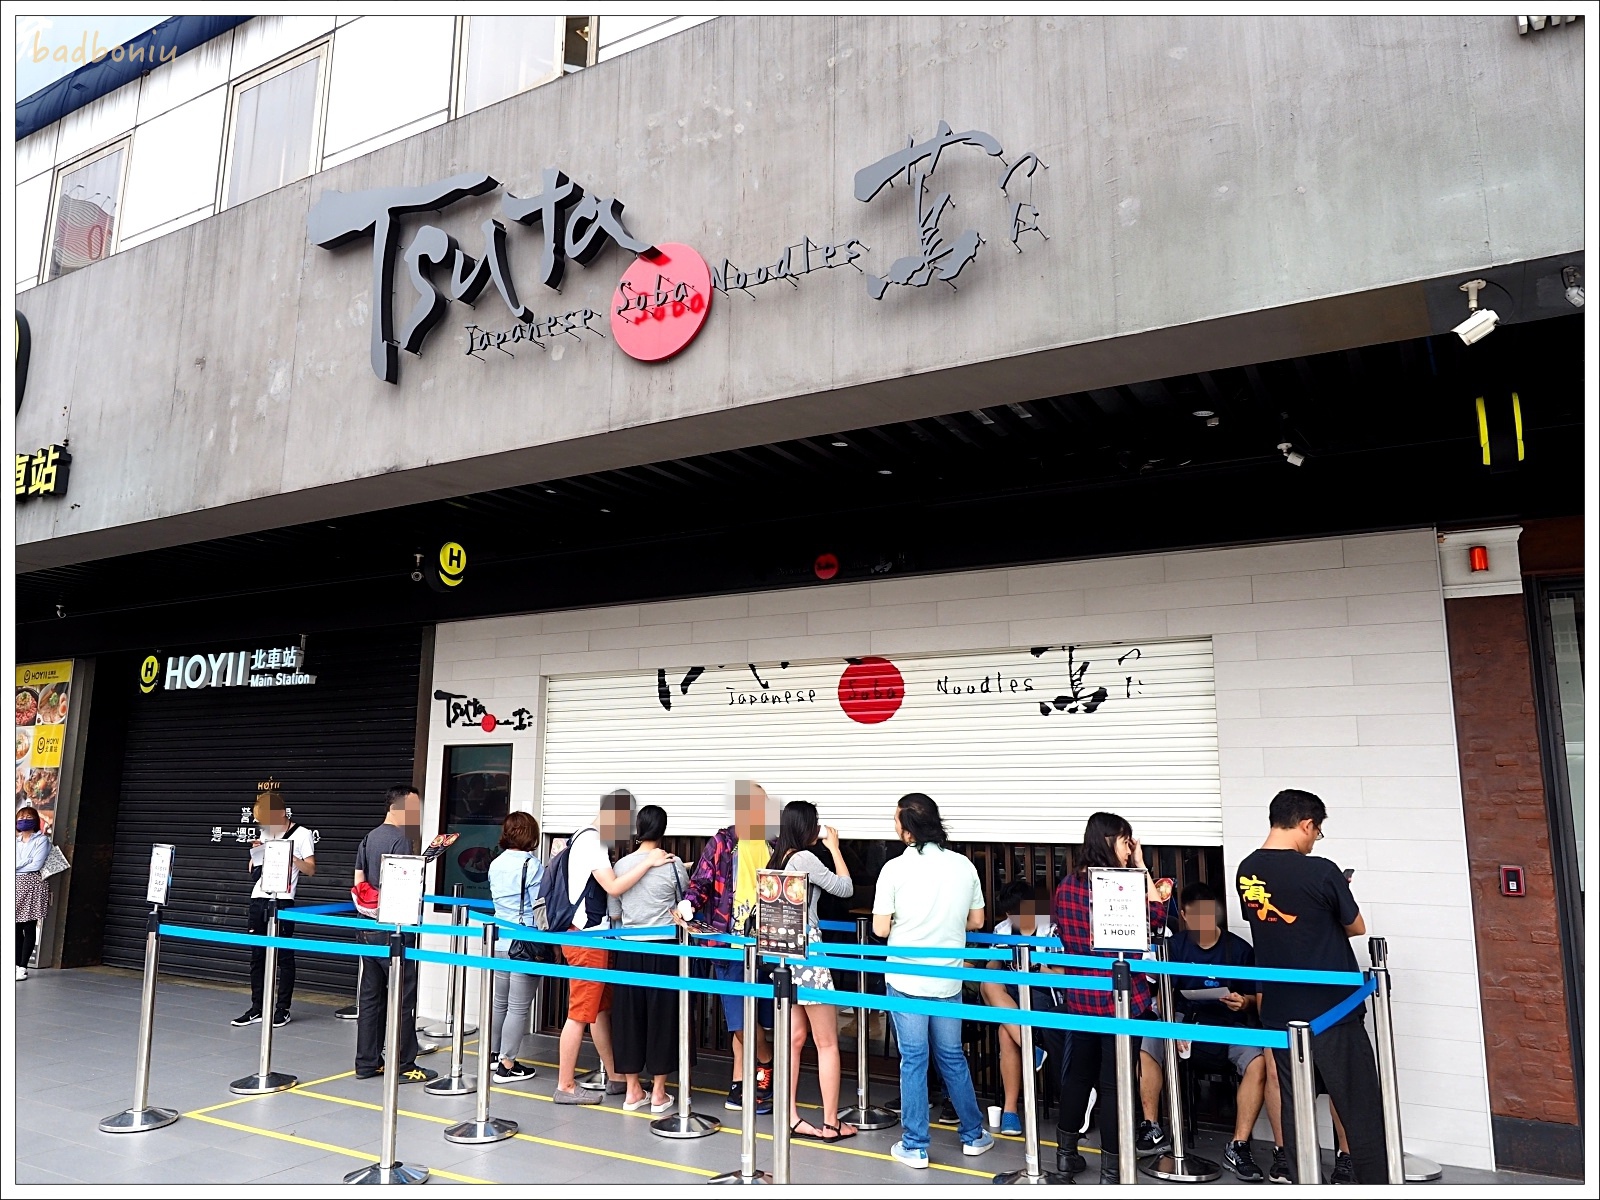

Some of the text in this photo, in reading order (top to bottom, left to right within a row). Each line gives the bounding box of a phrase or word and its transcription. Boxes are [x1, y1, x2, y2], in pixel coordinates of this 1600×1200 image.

[307, 167, 660, 385] Tsuta
[465, 234, 863, 356] Japanese Soba Noodles
[164, 651, 248, 690] HOYII
[250, 646, 299, 670] 北車站
[250, 672, 310, 688] Main Station
[725, 687, 816, 706] Japanese
[848, 679, 897, 700] Soba
[936, 672, 1034, 695] Noodles
[433, 690, 488, 729] Tsuta
